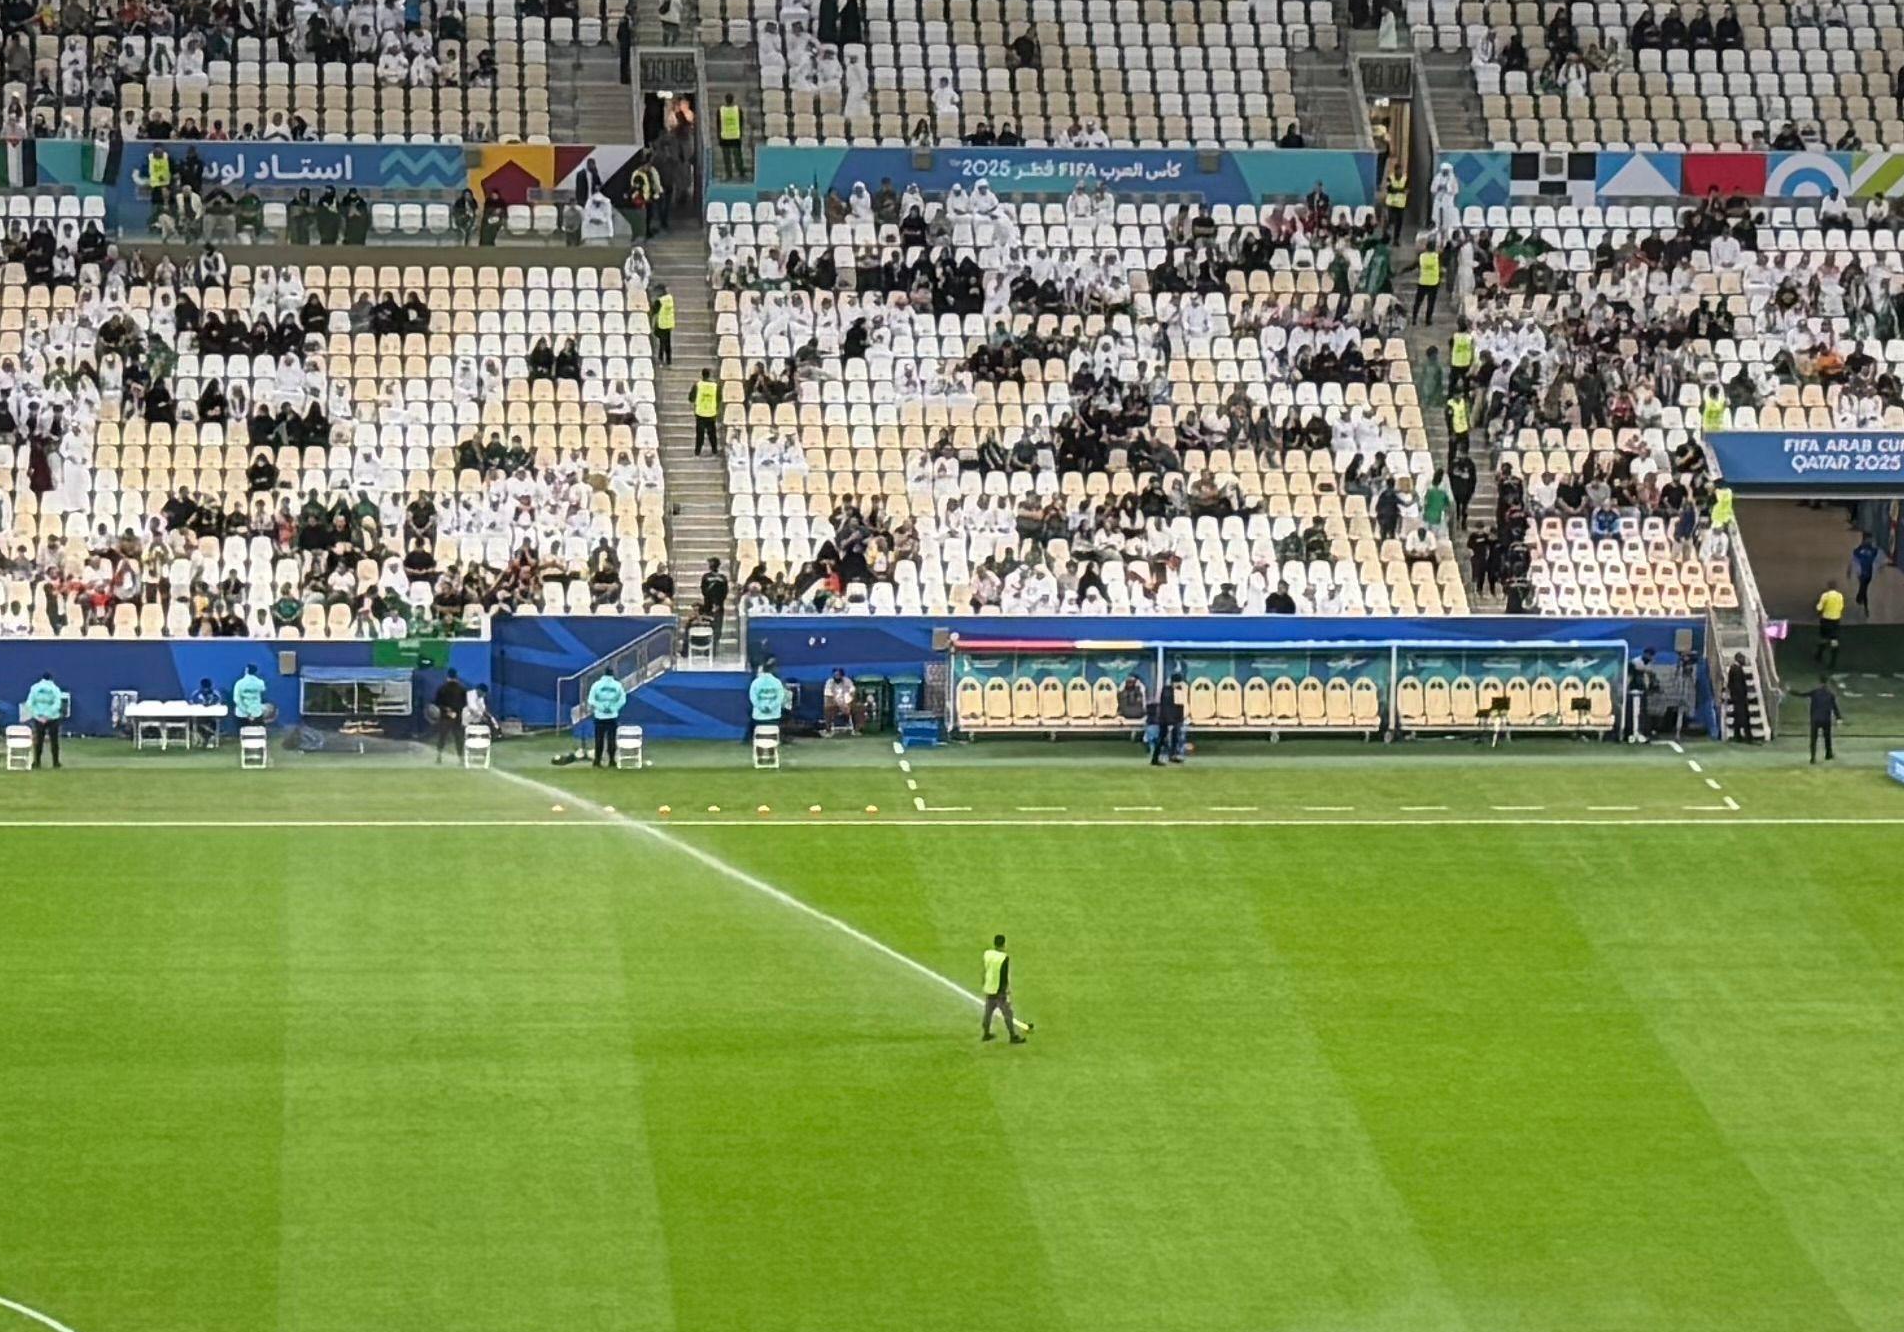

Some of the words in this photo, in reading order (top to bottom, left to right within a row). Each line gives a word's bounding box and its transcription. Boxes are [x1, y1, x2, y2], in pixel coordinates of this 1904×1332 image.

[1013, 160, 1055, 181] قطر
[1058, 162, 1097, 178] FIFA
[1100, 163, 1143, 181] العرب
[1144, 160, 1183, 180] كأس
[1783, 438, 1820, 452] FIFA
[1824, 438, 1873, 453] ARAB
[1791, 454, 1851, 474] QATAR
